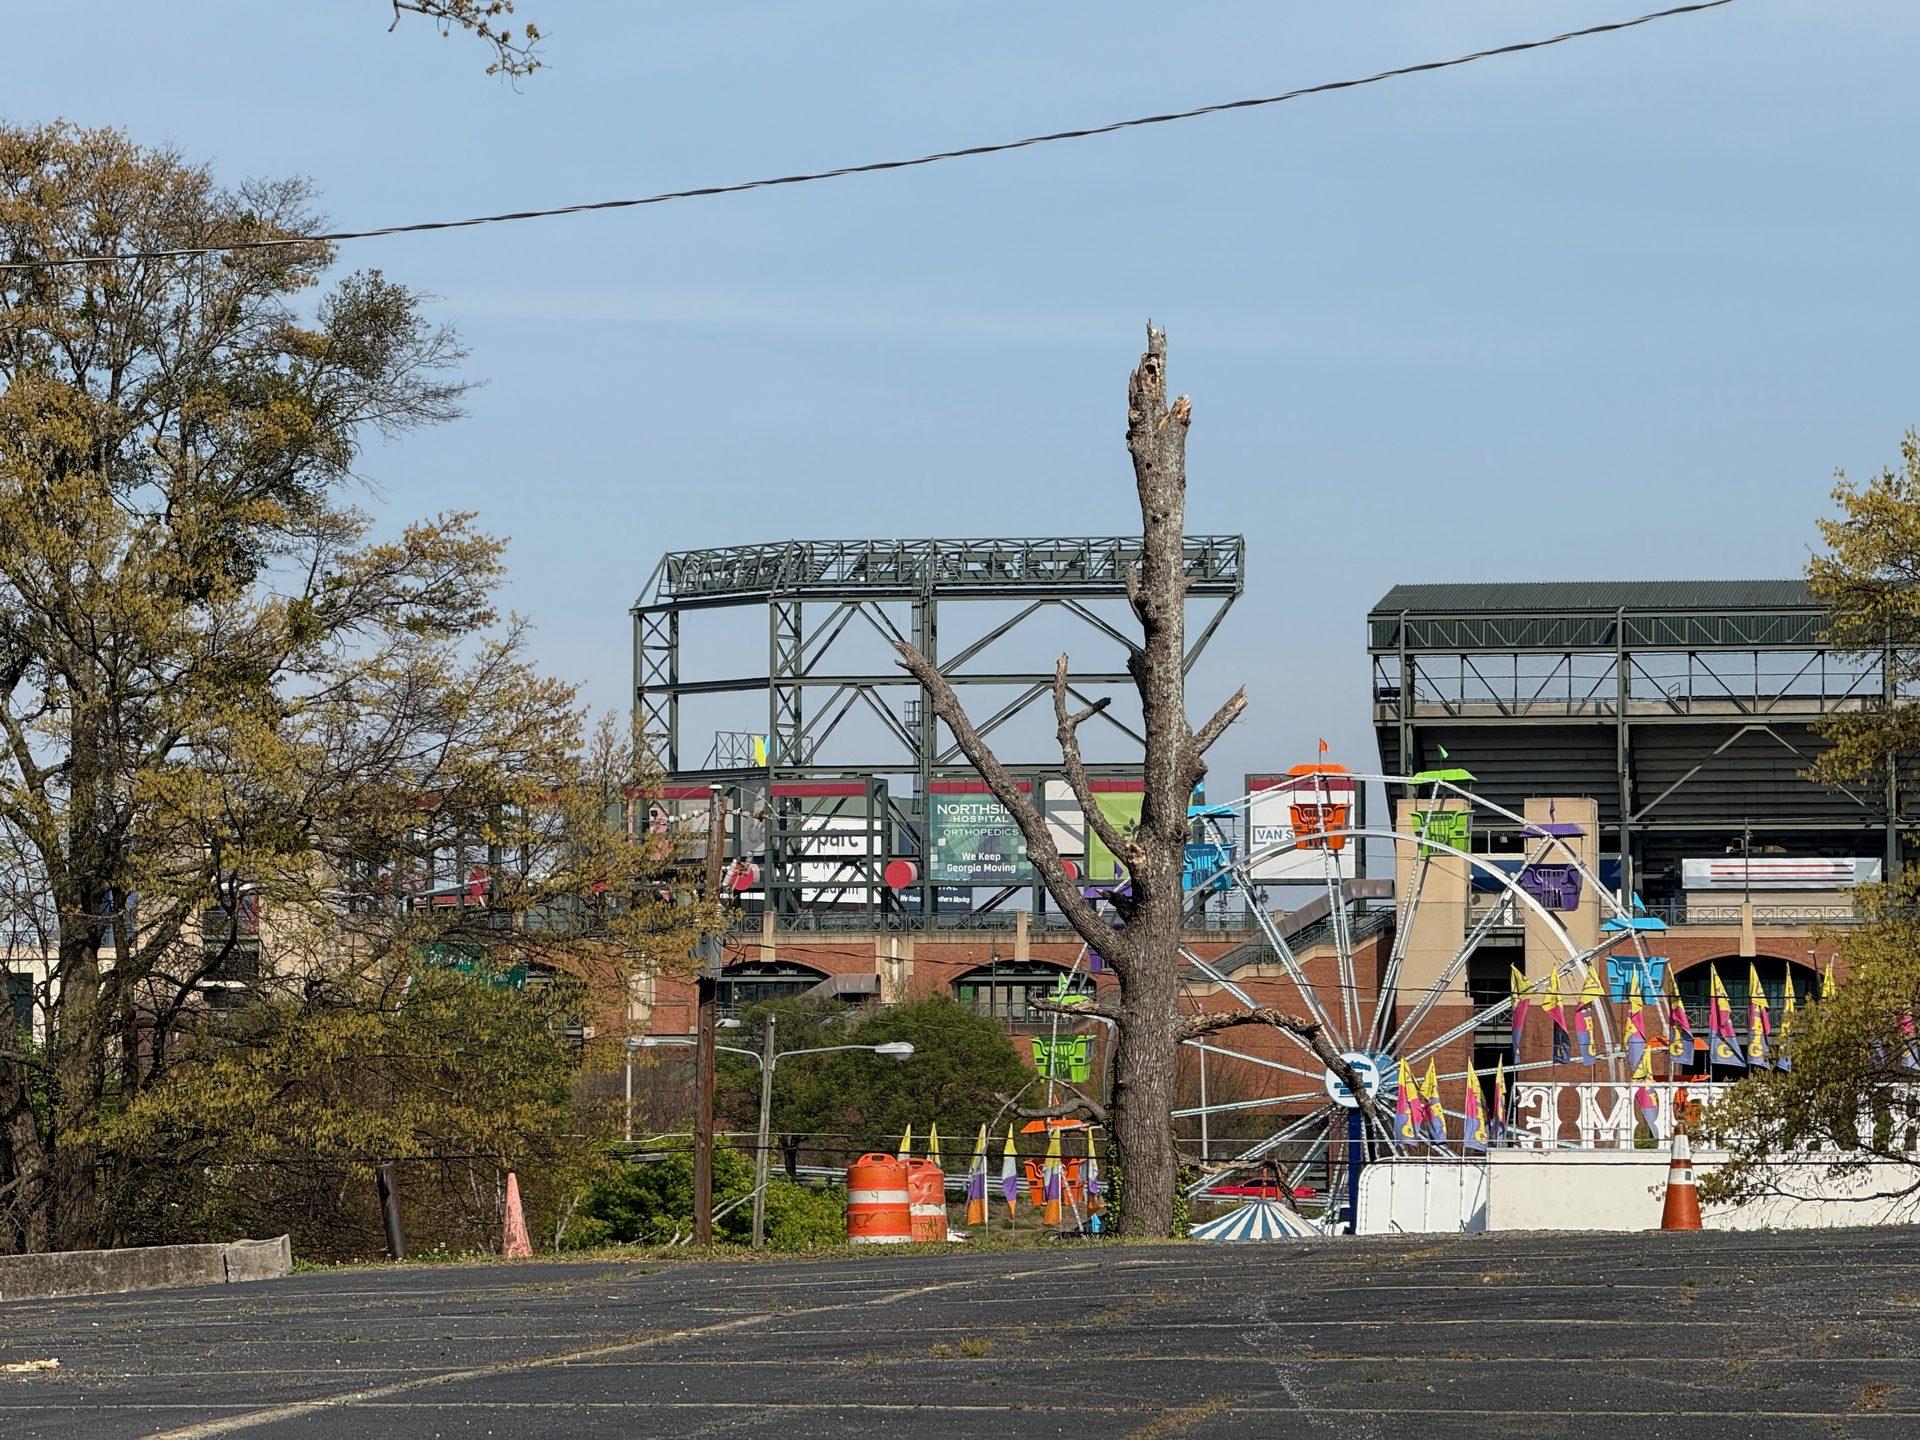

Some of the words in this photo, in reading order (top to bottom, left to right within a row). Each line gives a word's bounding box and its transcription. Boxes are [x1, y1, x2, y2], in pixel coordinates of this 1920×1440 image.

[937, 804, 1010, 815] NORTHSI
[953, 815, 1009, 823] HOSPITAL
[943, 828, 1019, 836] ORTHOPEDICS
[1257, 830, 1282, 840] VAN
[962, 853, 976, 861] We
[978, 853, 1001, 862] Keep
[947, 864, 981, 874] Georgia
[983, 864, 1016, 874] Moving
